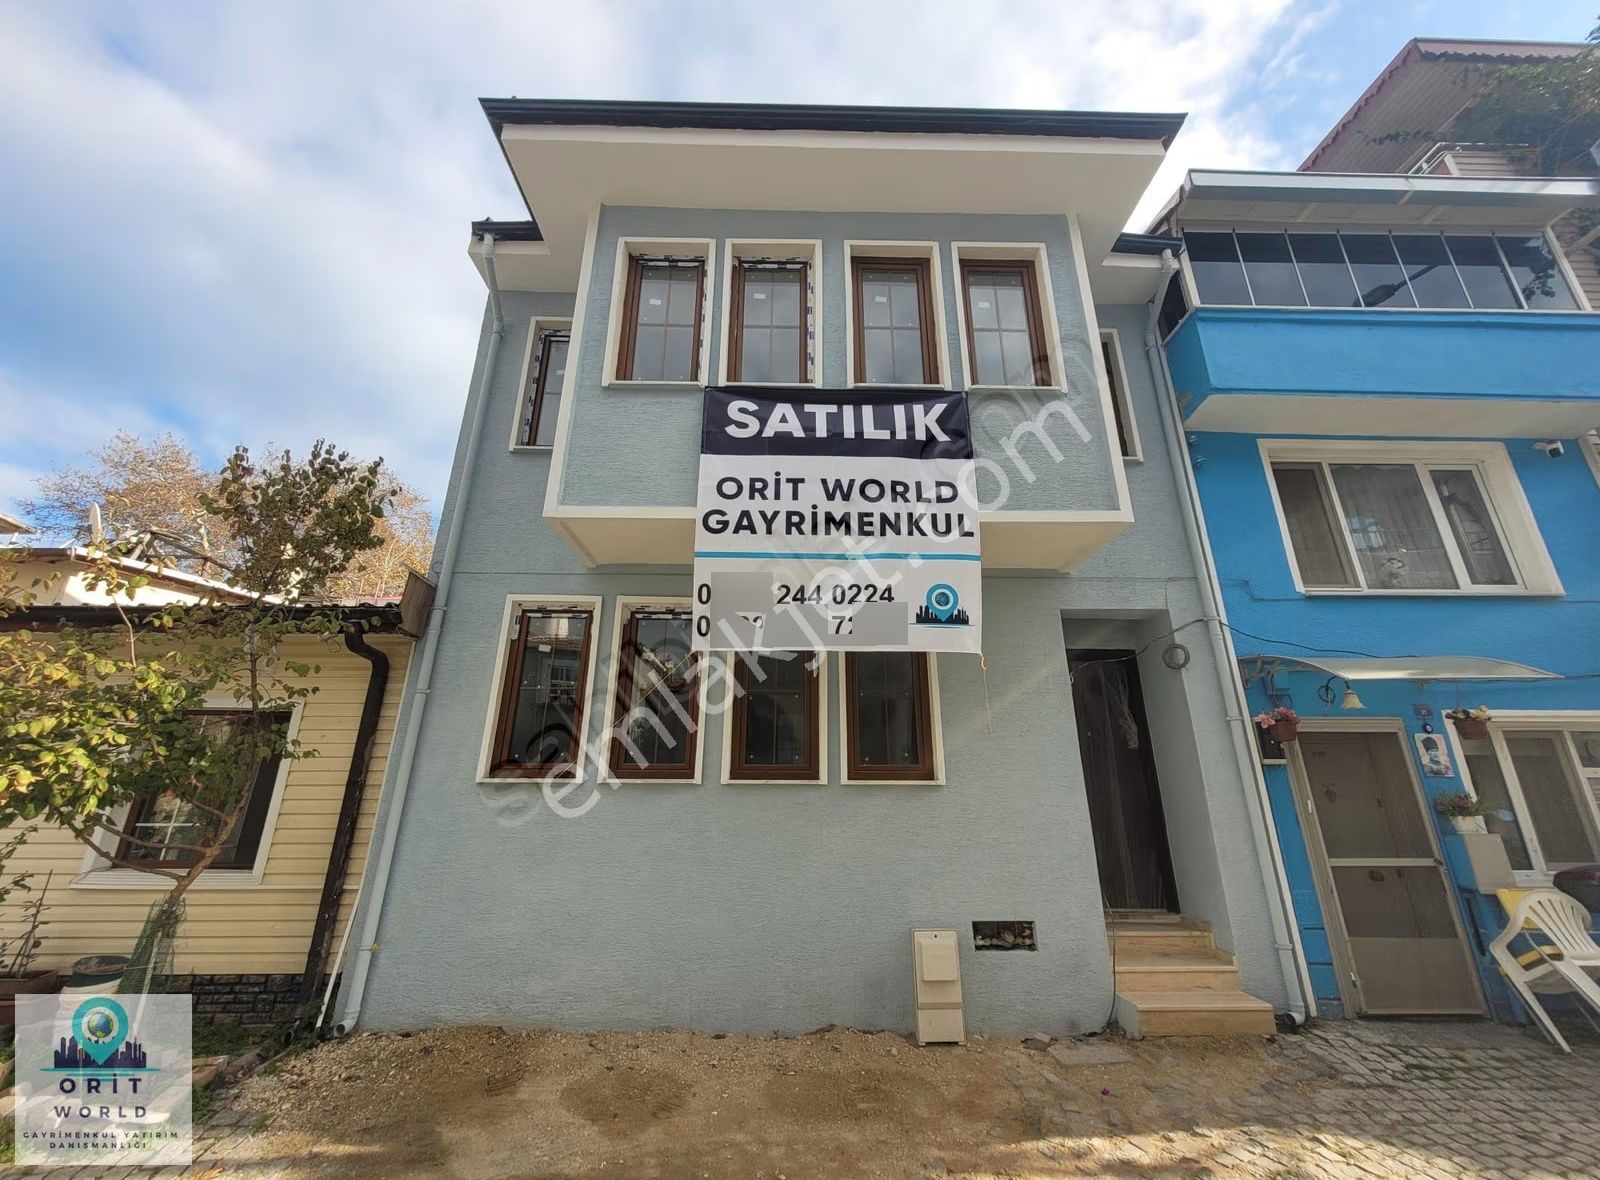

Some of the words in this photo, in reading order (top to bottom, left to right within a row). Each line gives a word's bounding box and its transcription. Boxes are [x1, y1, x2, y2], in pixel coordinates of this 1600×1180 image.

[724, 399, 952, 442] SATILIK
[715, 471, 806, 501] ORİT
[820, 477, 959, 504] WORLD
[702, 504, 975, 538] GAYRİMENKUL
[776, 584, 823, 604] 244
[832, 584, 895, 605] 0224
